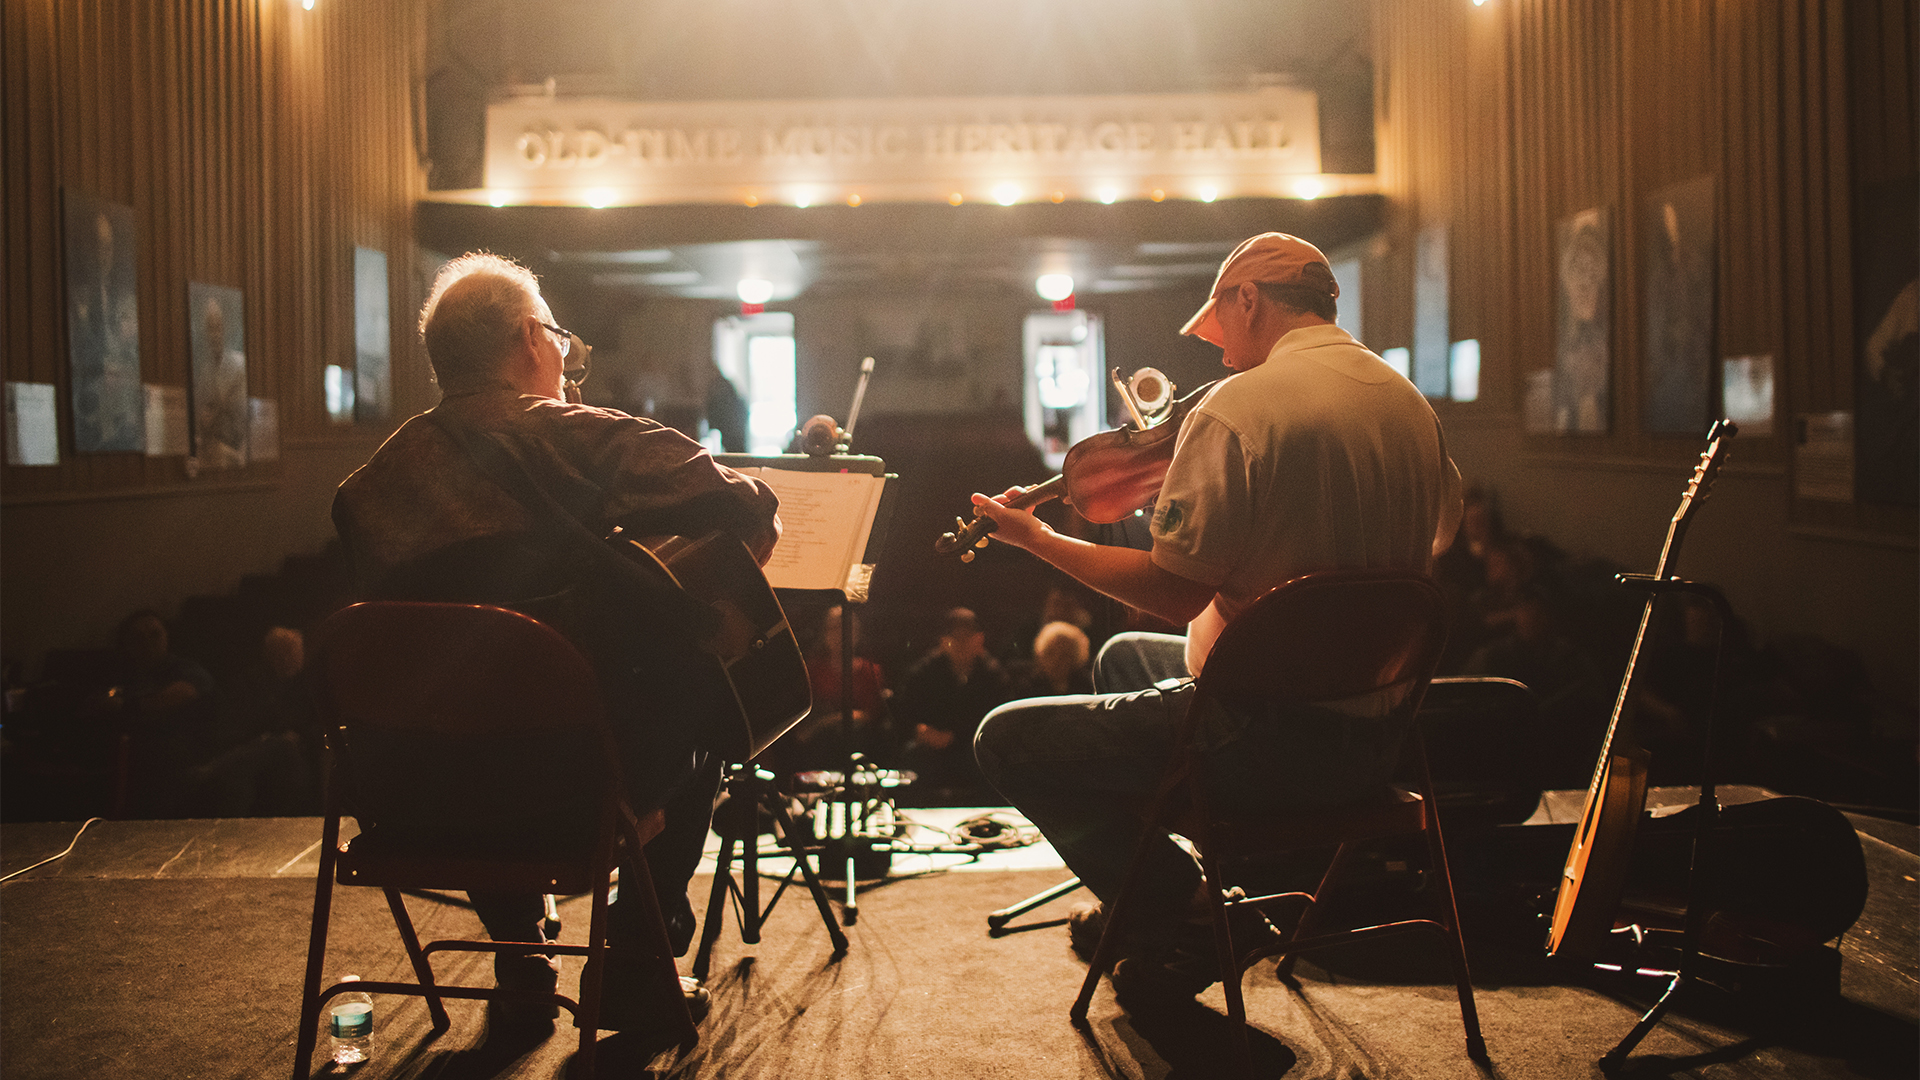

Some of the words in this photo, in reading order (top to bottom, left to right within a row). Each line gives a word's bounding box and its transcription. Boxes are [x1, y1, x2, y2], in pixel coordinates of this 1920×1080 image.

[516, 128, 743, 170] OLD-TIME
[761, 126, 908, 165] MUSIC
[923, 122, 1156, 162] HERITAGE
[1172, 120, 1296, 160] HALL
